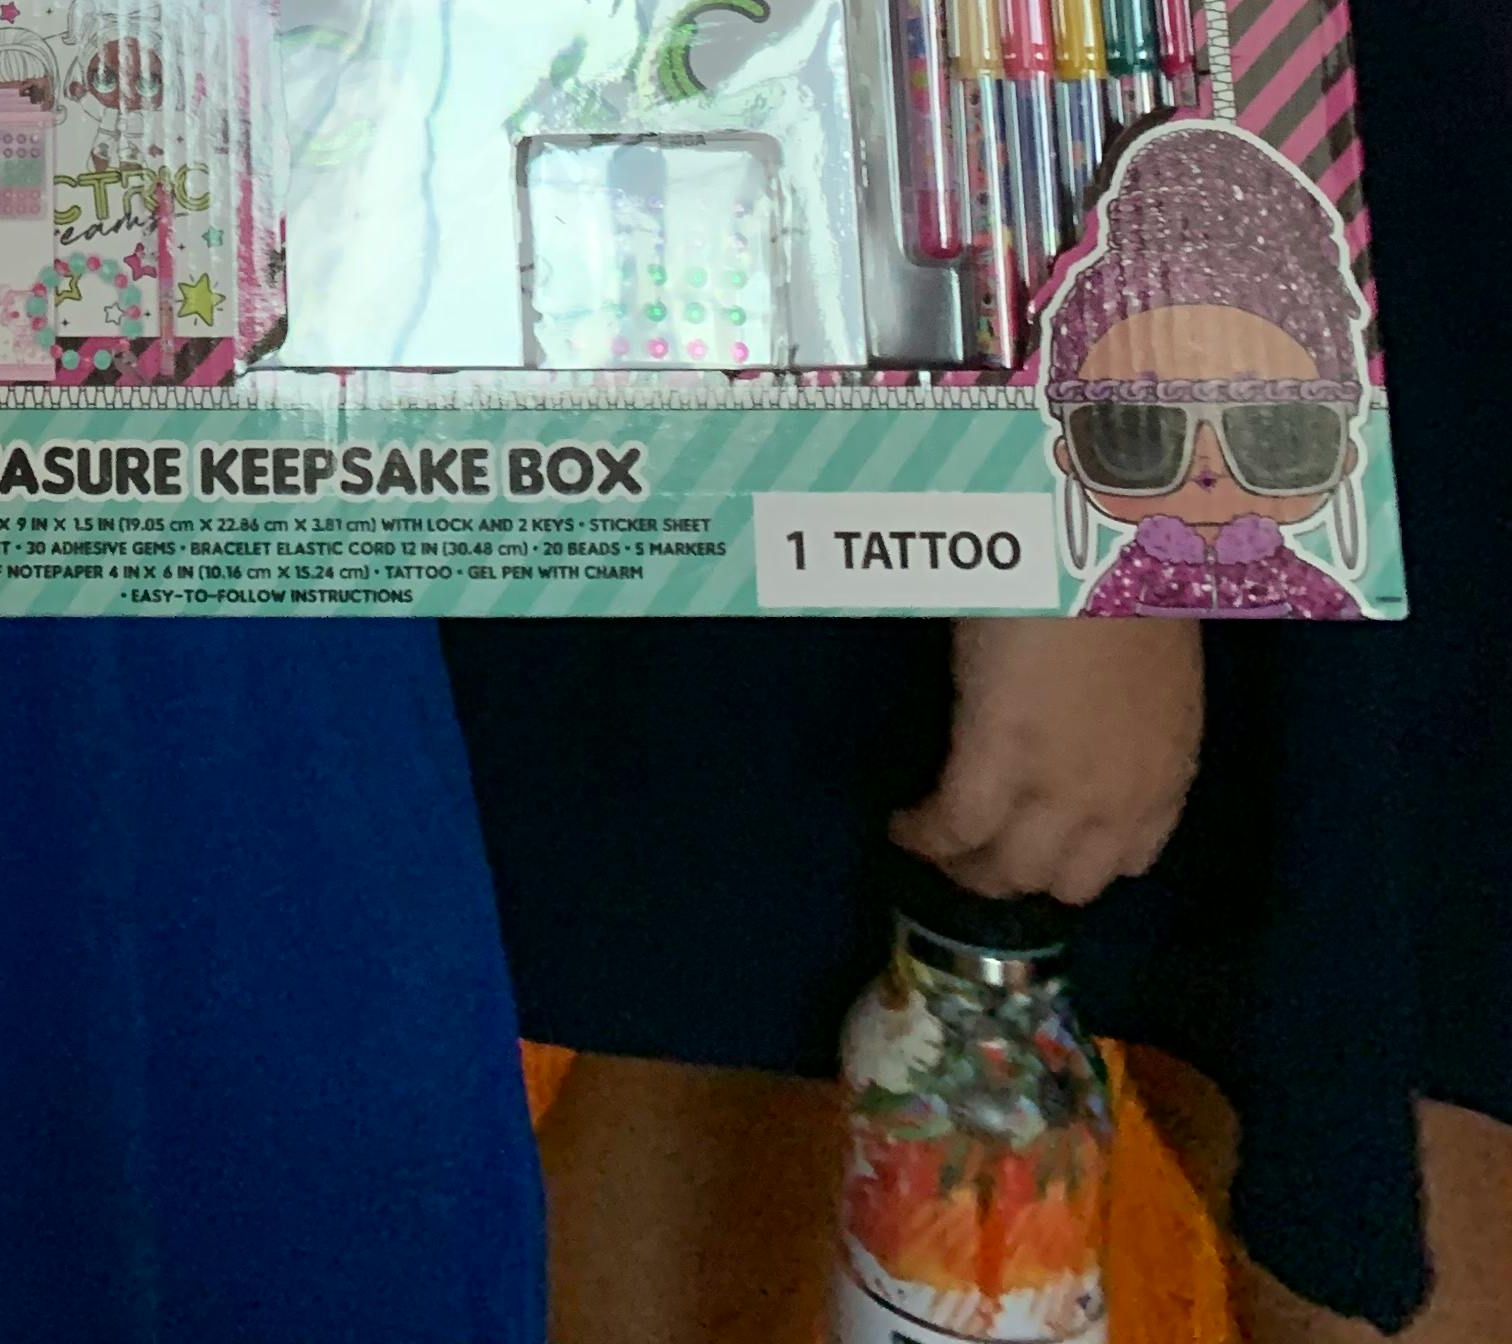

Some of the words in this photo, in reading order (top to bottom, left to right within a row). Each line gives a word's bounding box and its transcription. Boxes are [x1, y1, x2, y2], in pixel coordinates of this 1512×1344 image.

[201, 445, 491, 496] KEEPSAKE
[508, 447, 643, 497] BOX
[16, 517, 26, 531] 9
[31, 517, 48, 531] IN
[53, 518, 66, 531] X
[98, 518, 114, 531] IN
[170, 520, 192, 531] cm
[199, 518, 213, 531] X
[264, 521, 288, 532] cm
[294, 518, 307, 531] X
[346, 518, 377, 533] cm)
[381, 518, 423, 532] WITH
[427, 518, 473, 532] LOCK
[478, 518, 513, 532] AND
[518, 518, 528, 532] 2
[532, 518, 574, 532] KEYS
[589, 518, 658, 532] STICKER
[662, 518, 711, 532] SHEET
[51, 541, 127, 555] ADHESIVE
[132, 541, 175, 555] GEMS
[190, 541, 270, 555] BRACELET
[276, 541, 343, 555] ELASTIC
[348, 541, 396, 555] CORD
[401, 542, 417, 556] 12
[421, 542, 438, 556] IN
[498, 542, 528, 557] cm)
[543, 542, 563, 556] 20
[568, 542, 620, 556] BEADS
[634, 542, 644, 556] 5
[649, 542, 726, 556] MARKERS
[785, 530, 807, 571] 1
[834, 529, 1023, 572] TATTOO
[7, 565, 103, 579] NOTEPAPER
[109, 565, 119, 579] 4
[123, 566, 139, 579] IN
[143, 565, 156, 579] X
[163, 566, 172, 579] 6
[177, 565, 193, 579] IN
[247, 568, 271, 579] cm
[277, 566, 290, 579] X
[295, 566, 335, 579] 15.24
[339, 565, 370, 581] cm)
[387, 565, 453, 579] TATTOO
[468, 565, 497, 579] GEL
[502, 565, 533, 579] PEN
[538, 565, 579, 579] WITH
[584, 565, 643, 579] CHARM
[131, 588, 286, 603] EASY-TO-FOLLOW
[291, 589, 413, 603] INSTRUCTIONS
